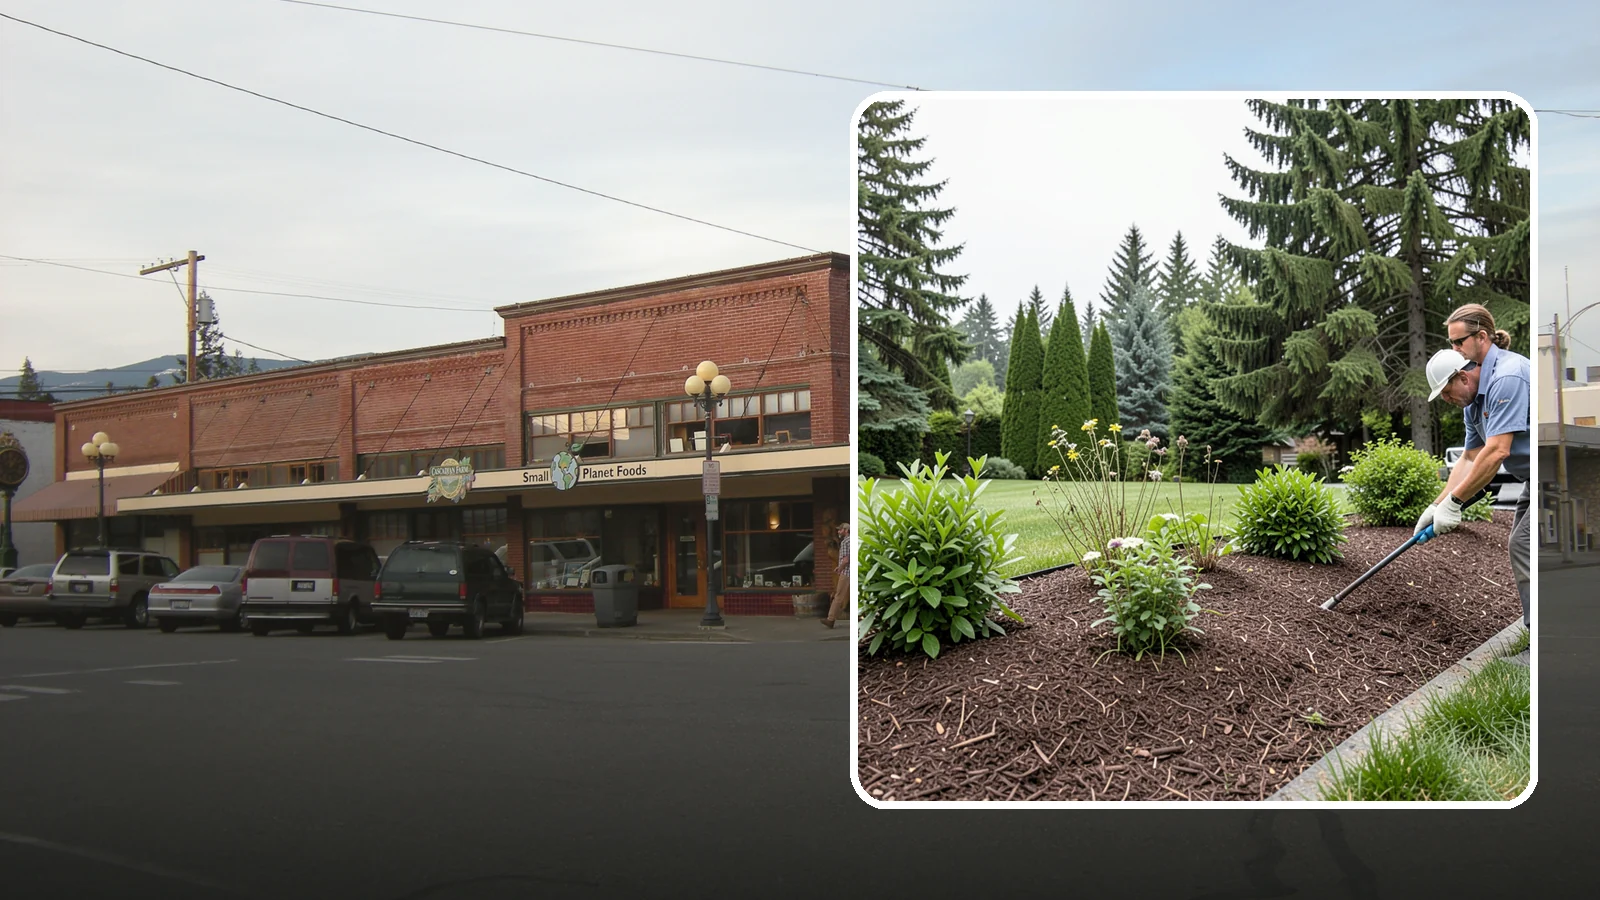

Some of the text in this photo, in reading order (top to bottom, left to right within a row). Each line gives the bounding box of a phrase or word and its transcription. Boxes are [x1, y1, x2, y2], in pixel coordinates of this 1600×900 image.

[523, 464, 647, 483] Small Planet Foods
